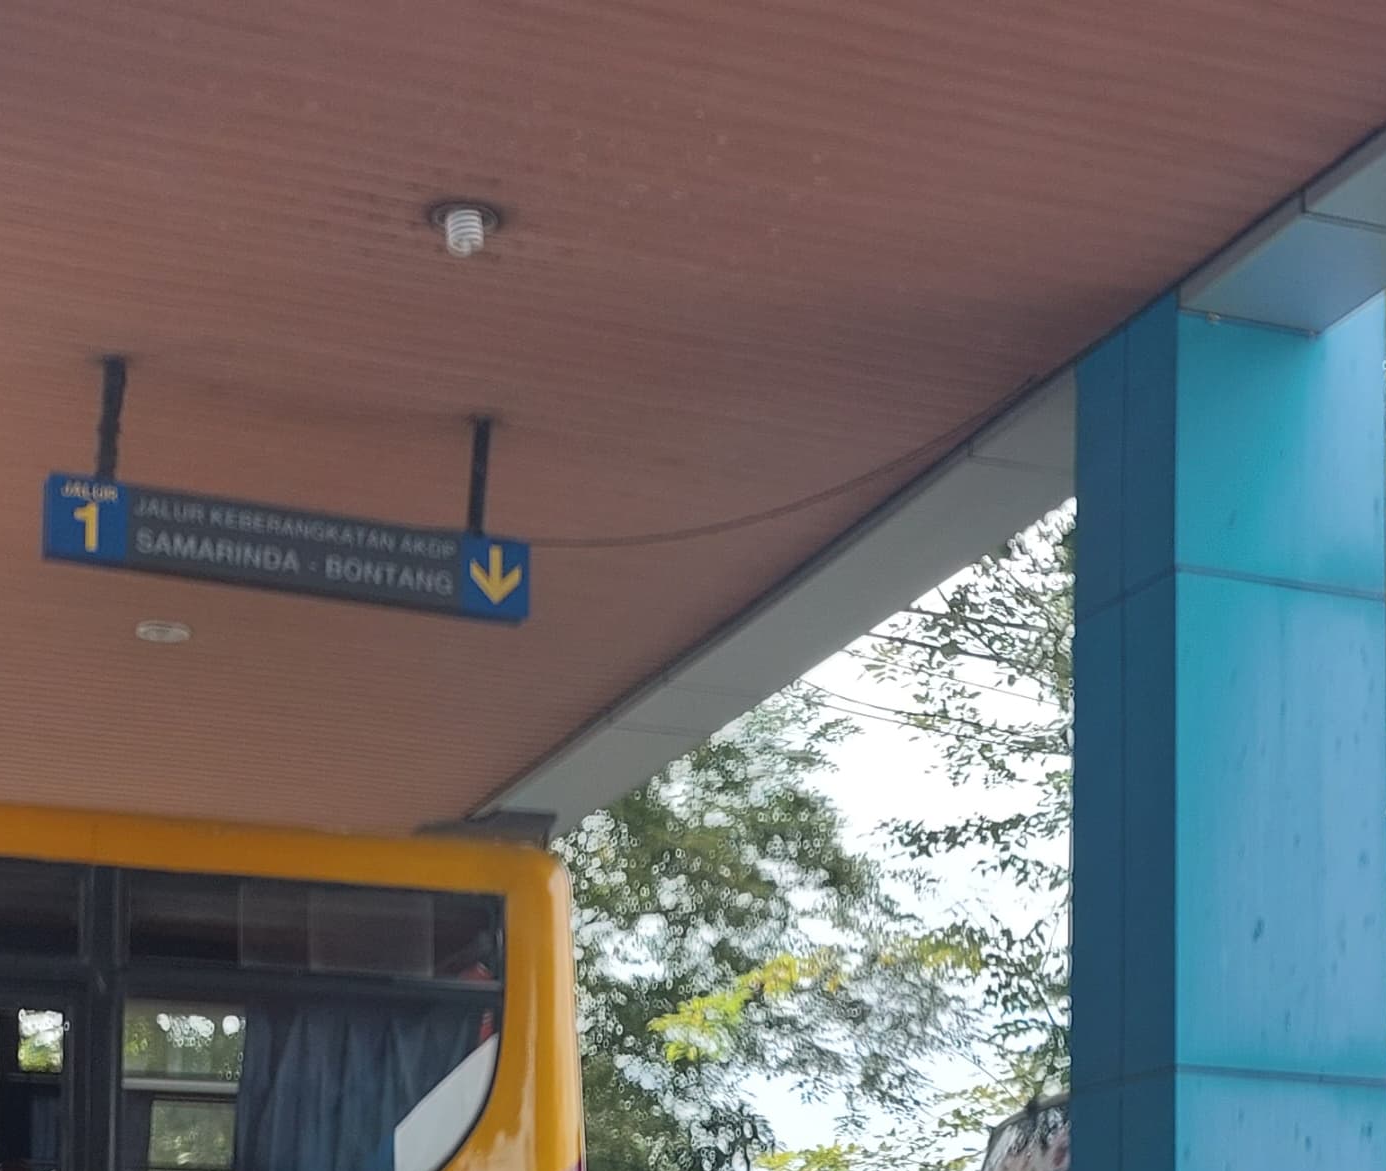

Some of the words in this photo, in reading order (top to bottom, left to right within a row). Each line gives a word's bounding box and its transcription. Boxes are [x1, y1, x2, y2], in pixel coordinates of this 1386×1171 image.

[61, 479, 118, 502] JALUR
[74, 501, 99, 552] 1
[133, 496, 205, 525] JALUR
[210, 504, 396, 553] KEBERANGKATAN
[135, 526, 300, 575] SAMARINDA
[325, 553, 455, 597] BONTANG
